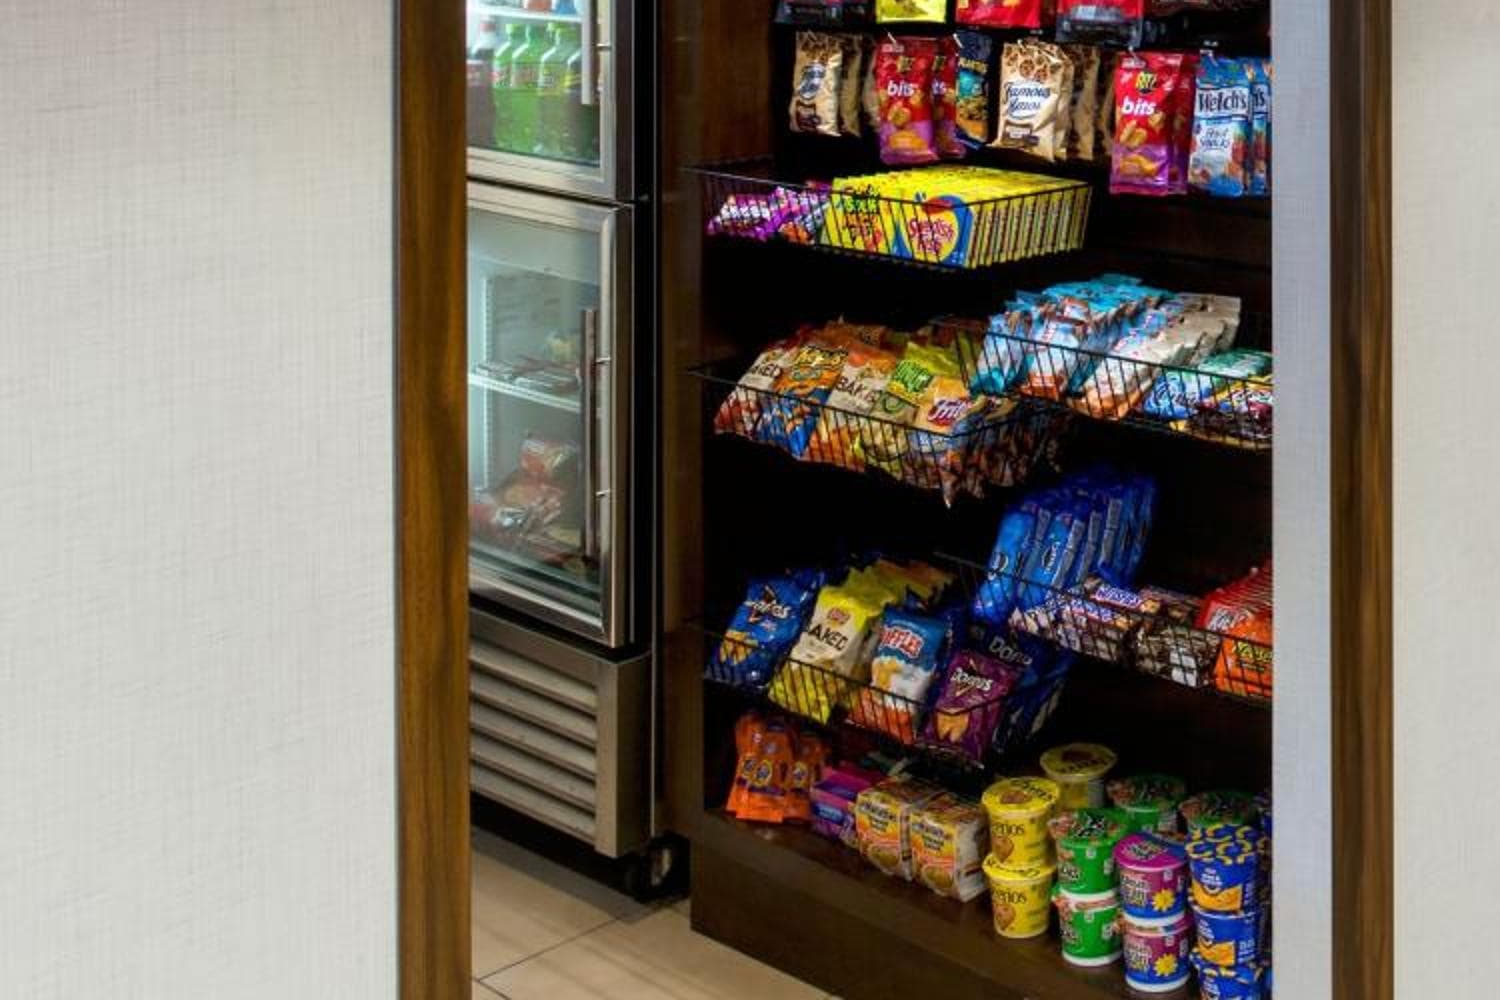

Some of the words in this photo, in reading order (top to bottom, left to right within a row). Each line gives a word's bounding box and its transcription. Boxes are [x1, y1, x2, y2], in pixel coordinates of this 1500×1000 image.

[1004, 81, 1051, 105] Famous
[1198, 90, 1248, 113] Welch's
[1121, 97, 1157, 115] bits
[836, 376, 879, 404] BAKE
[808, 624, 848, 651] AKED
[950, 667, 994, 692] Doritos
